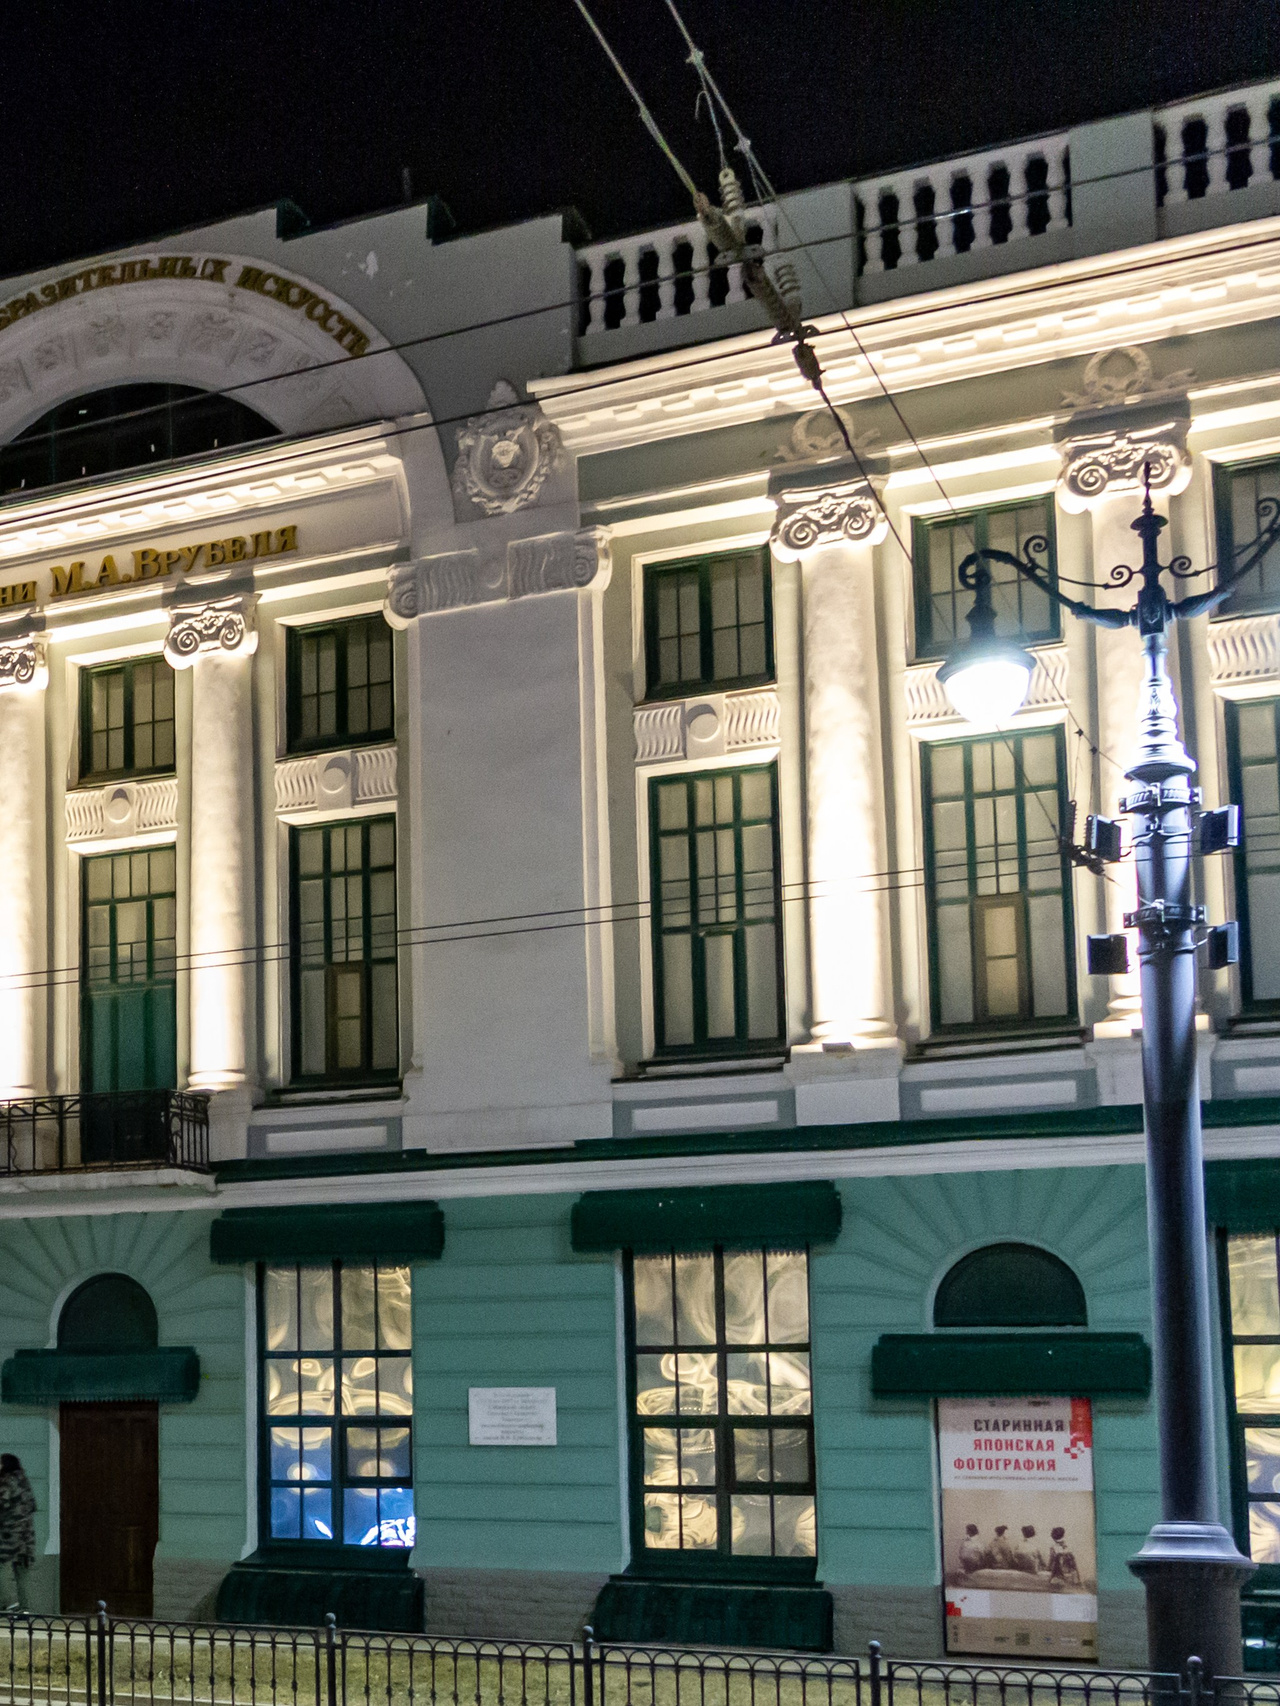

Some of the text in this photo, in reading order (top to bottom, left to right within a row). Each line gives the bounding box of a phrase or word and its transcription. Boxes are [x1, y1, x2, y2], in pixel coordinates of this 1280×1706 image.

[236, 267, 369, 357] ИСКУССТВ
[974, 1418, 1064, 1432] СТАРИННАЯ
[974, 1439, 1055, 1452] ЯПОНСКАЯ
[953, 1458, 1056, 1471] ФОТОГРАФИЯ
